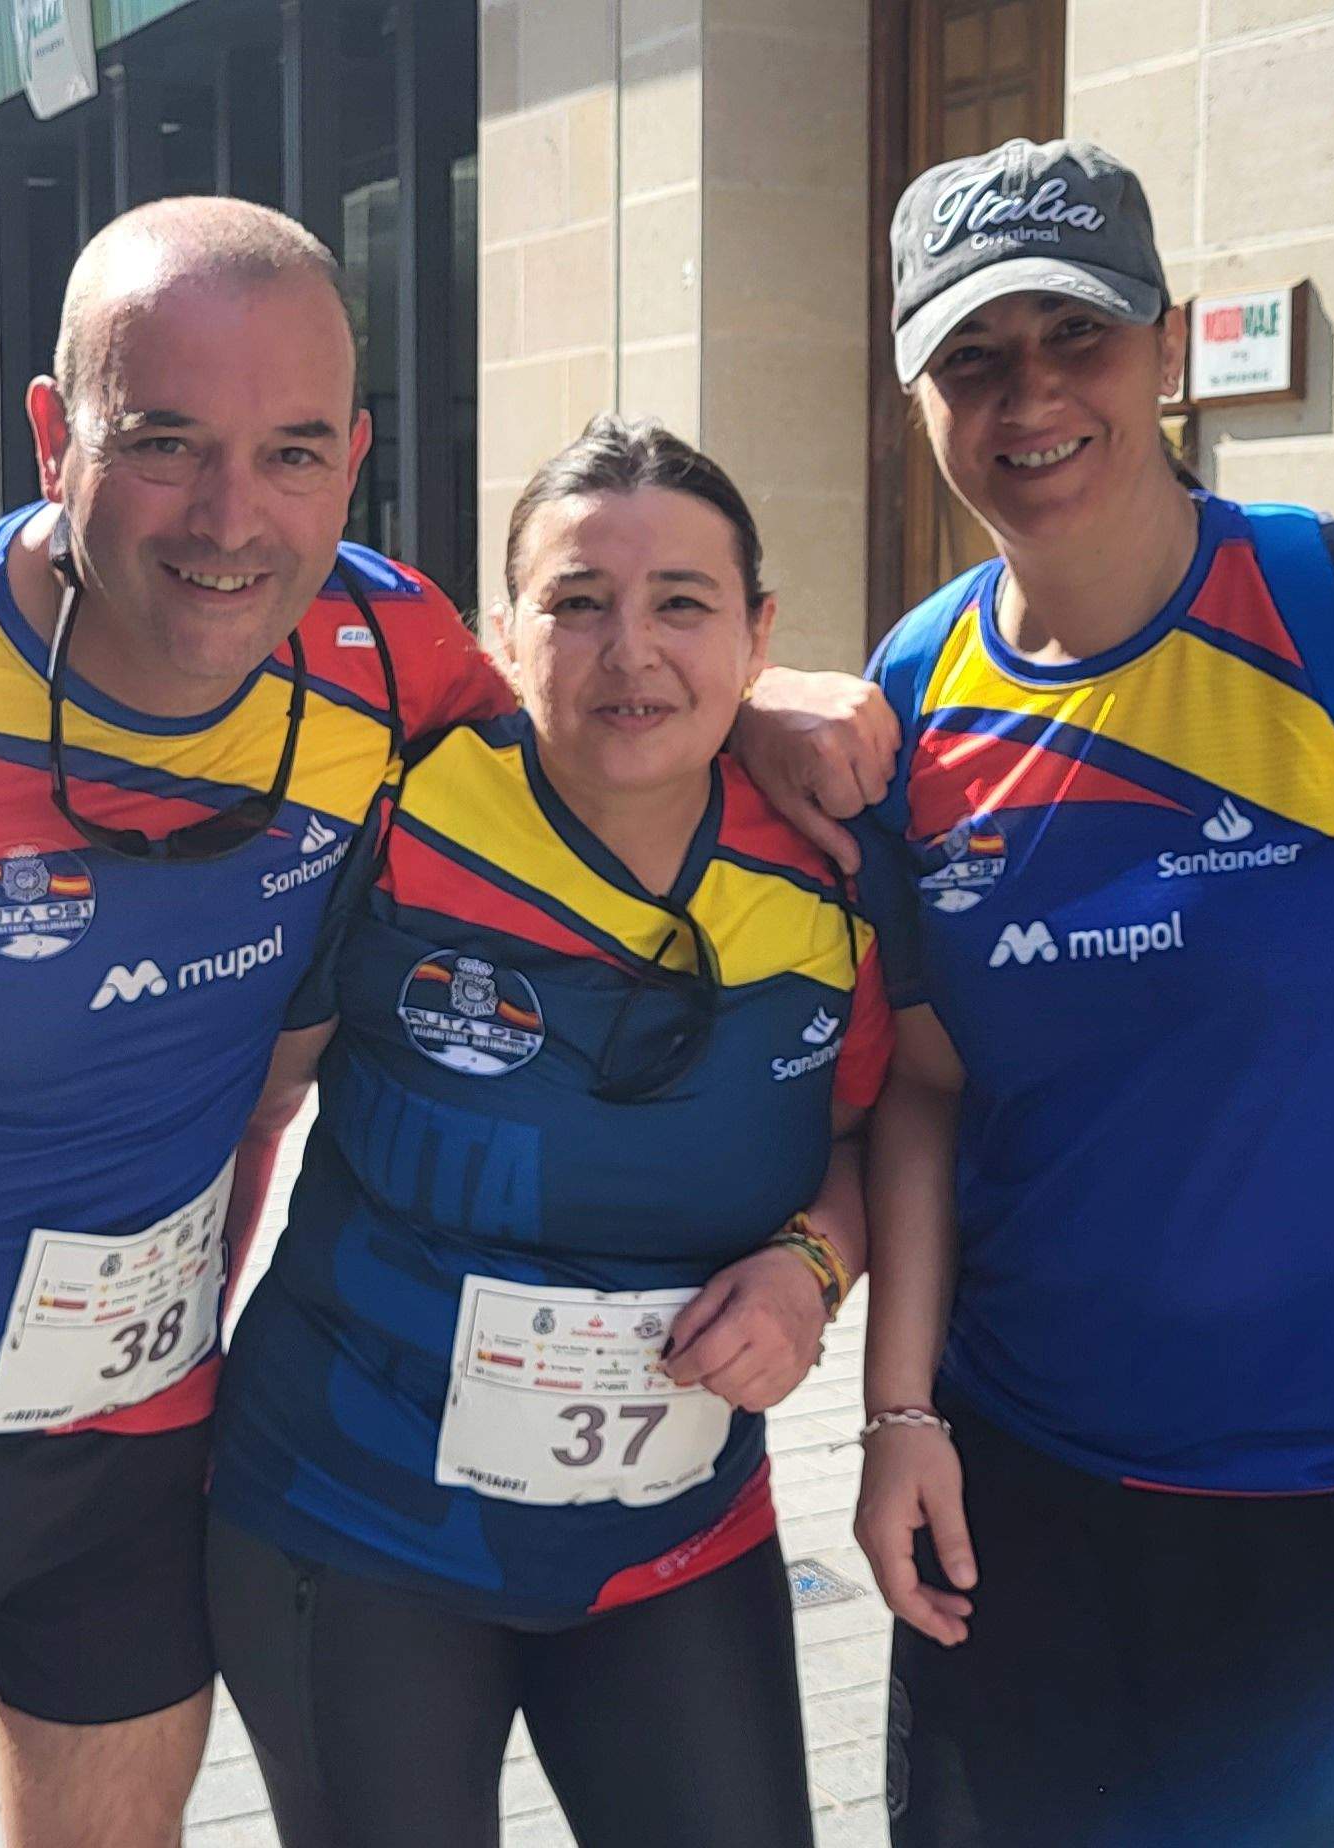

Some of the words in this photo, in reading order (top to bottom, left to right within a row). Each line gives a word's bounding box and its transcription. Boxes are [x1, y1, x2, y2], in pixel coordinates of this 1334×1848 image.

[261, 835, 353, 899] Santand
[1157, 843, 1303, 879] Santander
[178, 923, 285, 990] mupol
[1068, 910, 1185, 963] mupol
[770, 1036, 844, 1081] Santan
[99, 1299, 187, 1379] 38
[551, 1402, 669, 1466] 37
